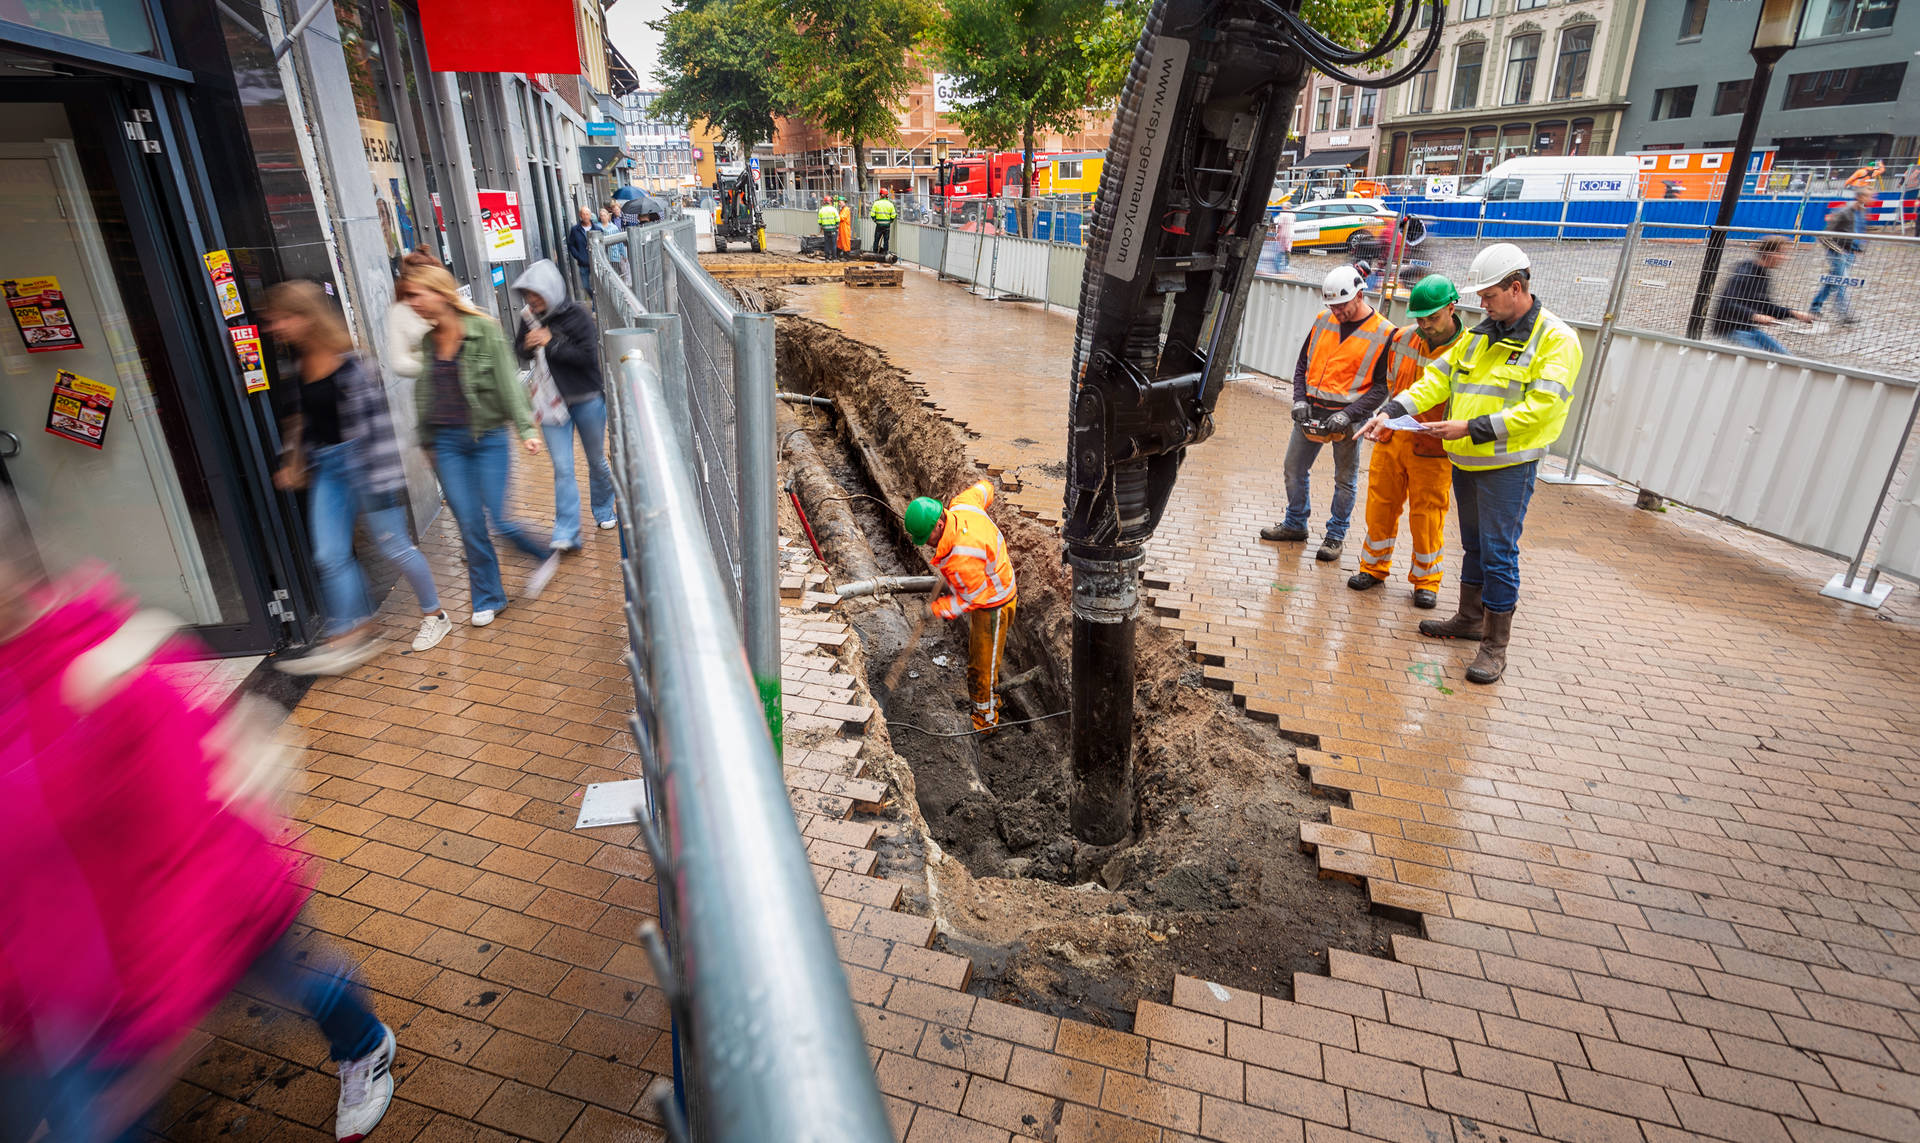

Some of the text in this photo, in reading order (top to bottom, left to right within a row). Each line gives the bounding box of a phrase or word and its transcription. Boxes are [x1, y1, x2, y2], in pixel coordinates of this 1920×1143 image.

[1412, 144, 1463, 153] FLYING TIGER
[1118, 58, 1175, 264] www.rsp-germany.com
[482, 213, 518, 233] SALE
[16, 307, 39, 316] 20%
[57, 396, 79, 409] 20%
